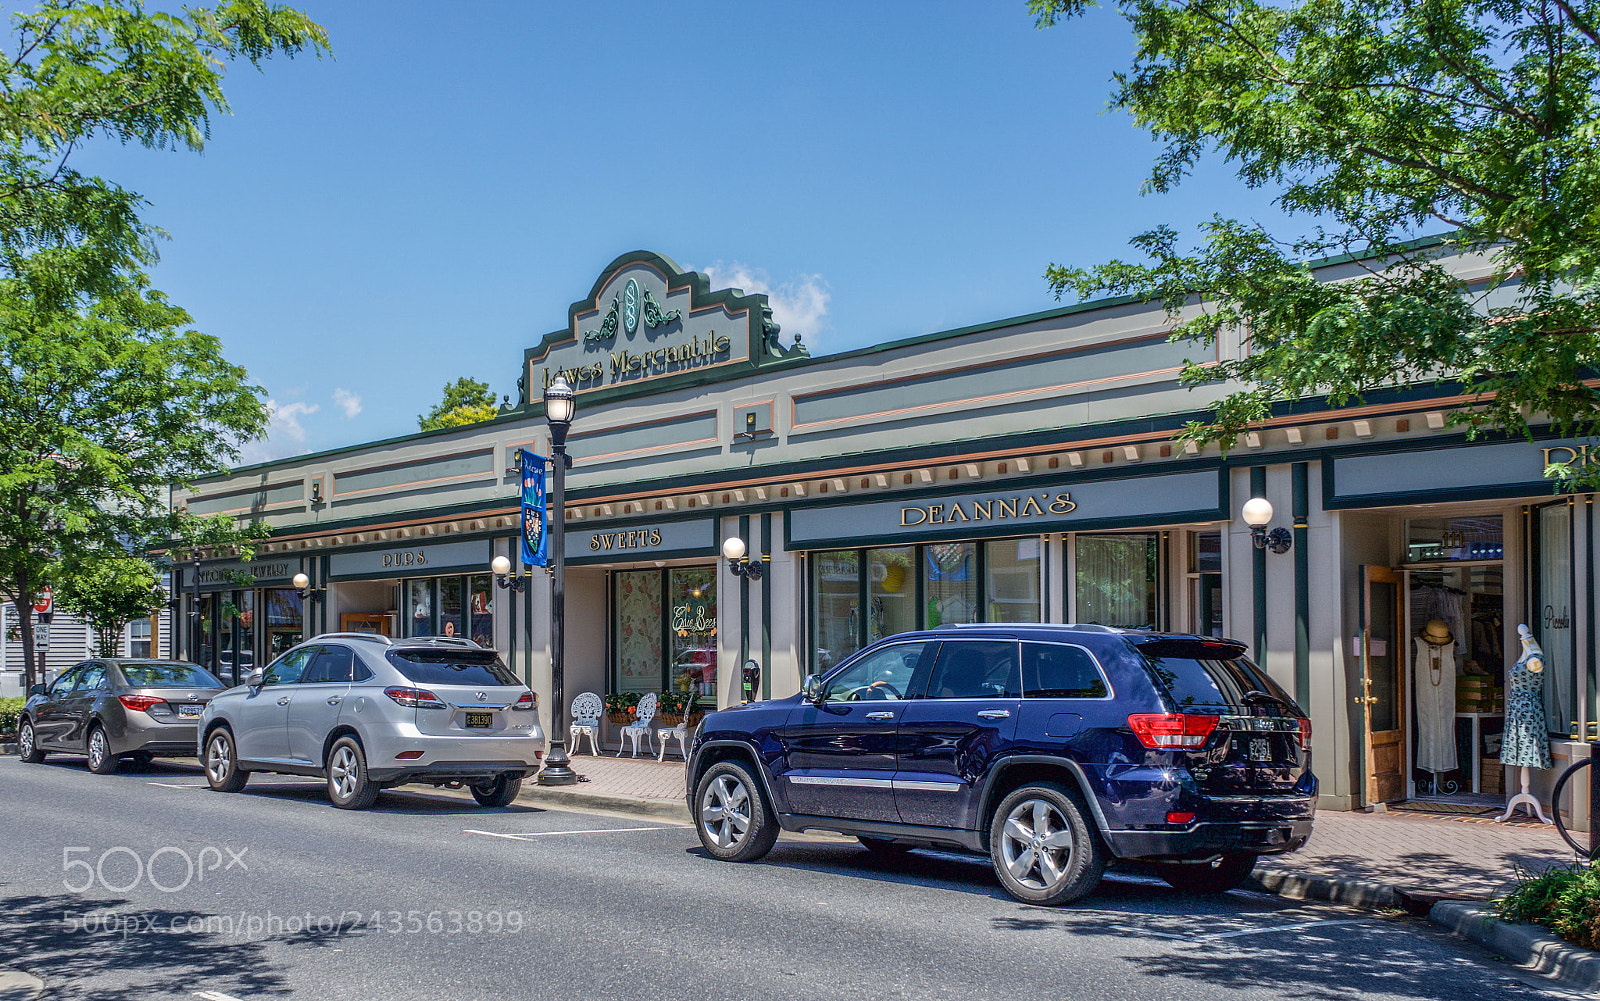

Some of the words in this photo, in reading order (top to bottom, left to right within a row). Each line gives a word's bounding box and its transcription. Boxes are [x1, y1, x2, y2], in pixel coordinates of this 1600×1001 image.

[610, 330, 731, 376] Mercantile
[899, 492, 1077, 526] DEANNA'S
[589, 527, 662, 551] SWEETS
[1442, 531, 1465, 548] 111
